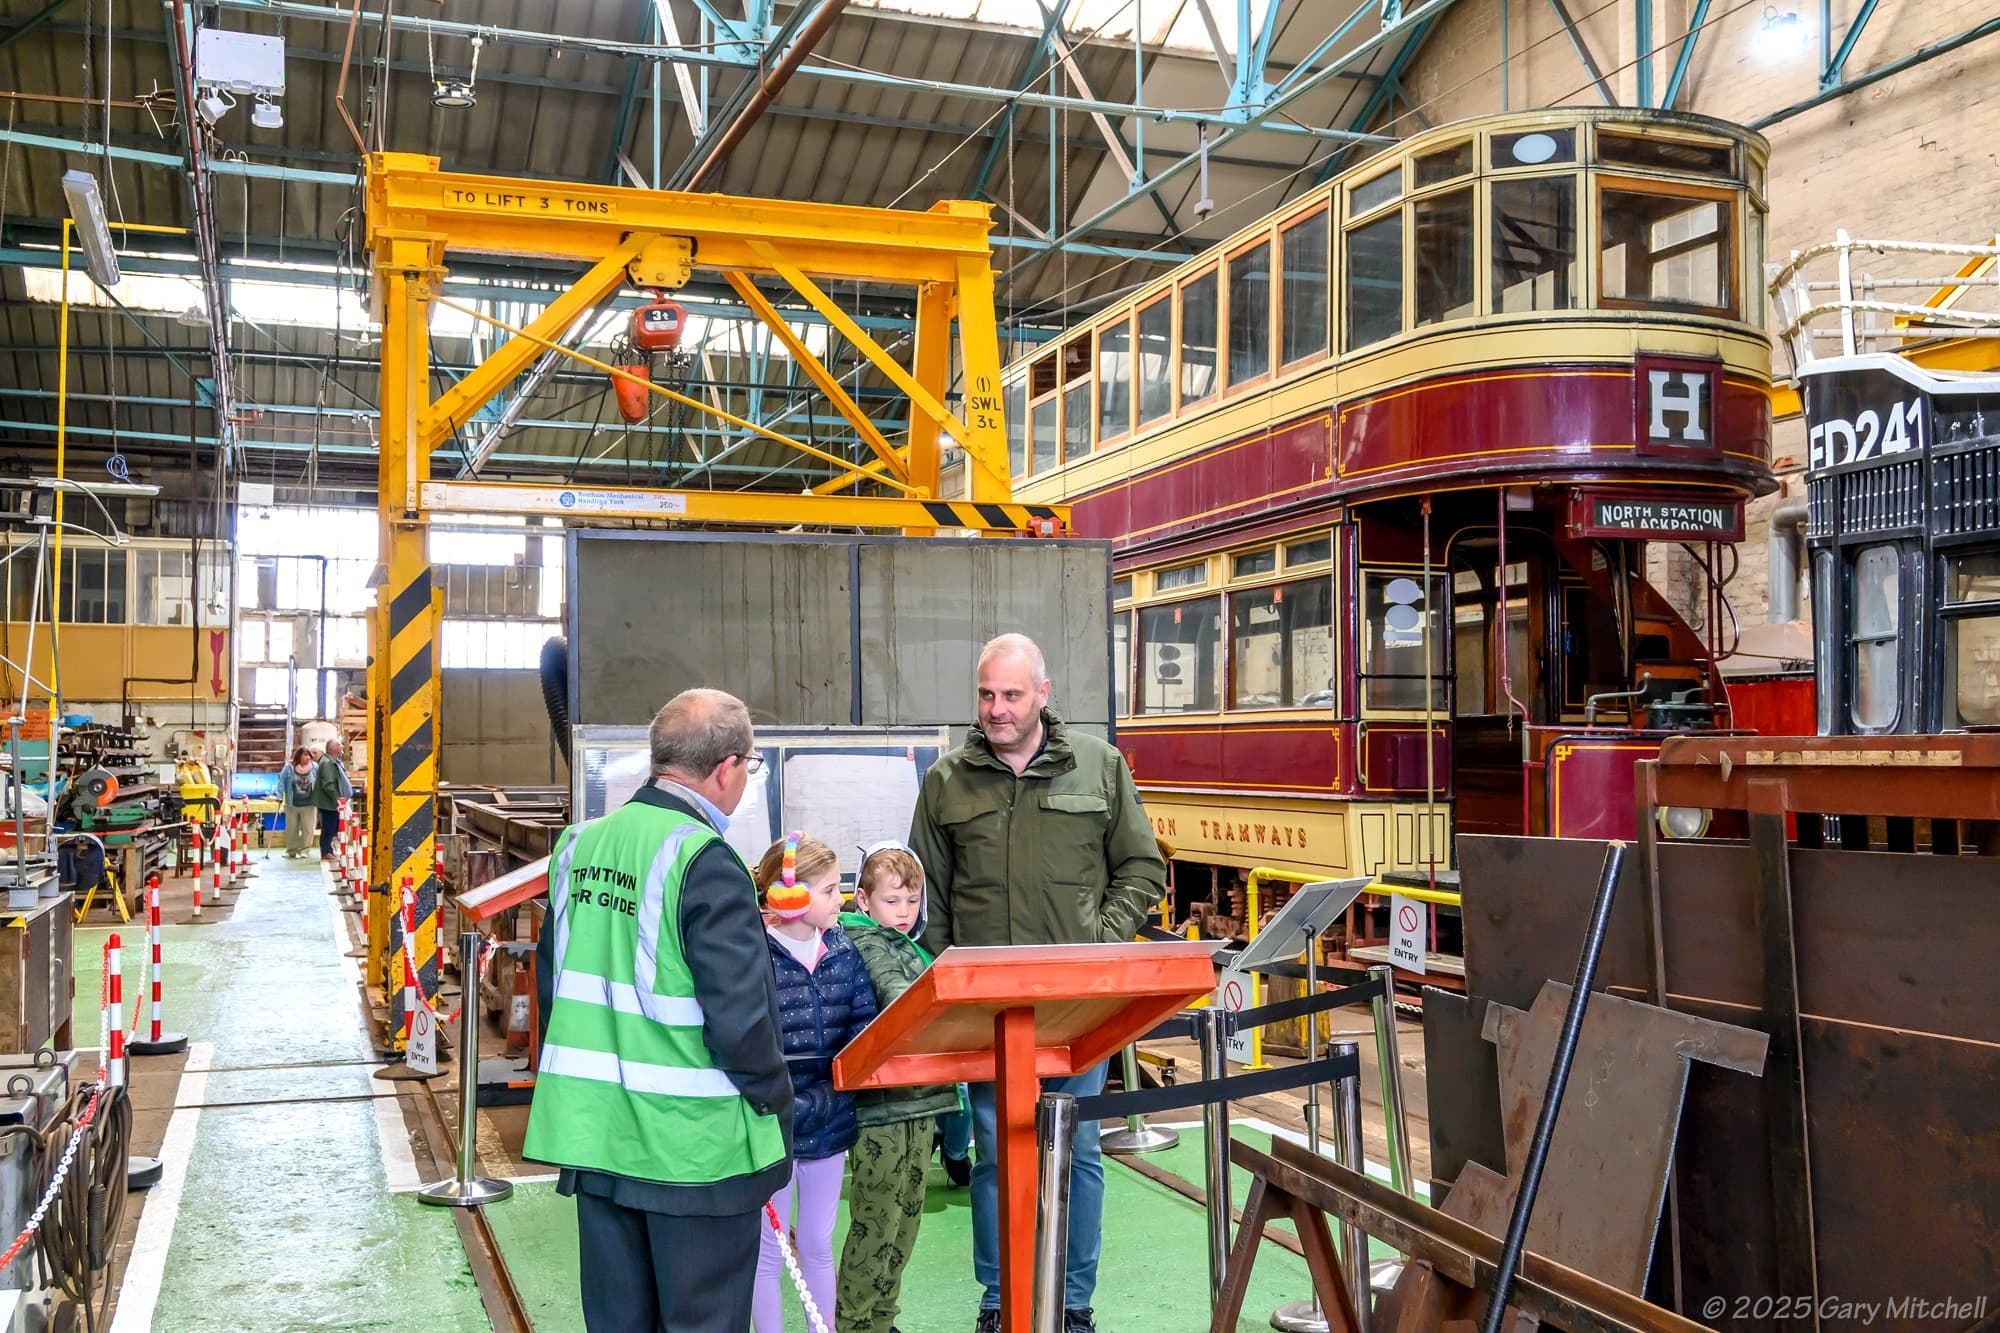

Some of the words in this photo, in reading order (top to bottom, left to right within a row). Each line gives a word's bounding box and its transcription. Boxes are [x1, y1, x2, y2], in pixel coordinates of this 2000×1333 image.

[453, 190, 475, 203] TO
[486, 193, 526, 207] LIFT
[540, 198, 549, 208] 3
[564, 200, 609, 213] TONS
[971, 396, 1001, 411] SWL
[1649, 370, 1705, 440] H
[1602, 505, 1651, 525] NORTH
[1661, 507, 1723, 529] STATION
[1200, 820, 1307, 848] TRAMWAYS
[1401, 938, 1413, 948] NO
[1394, 948, 1418, 963] ENTRY
[416, 1042, 425, 1051] NO
[411, 1052, 430, 1064] ENTRY
